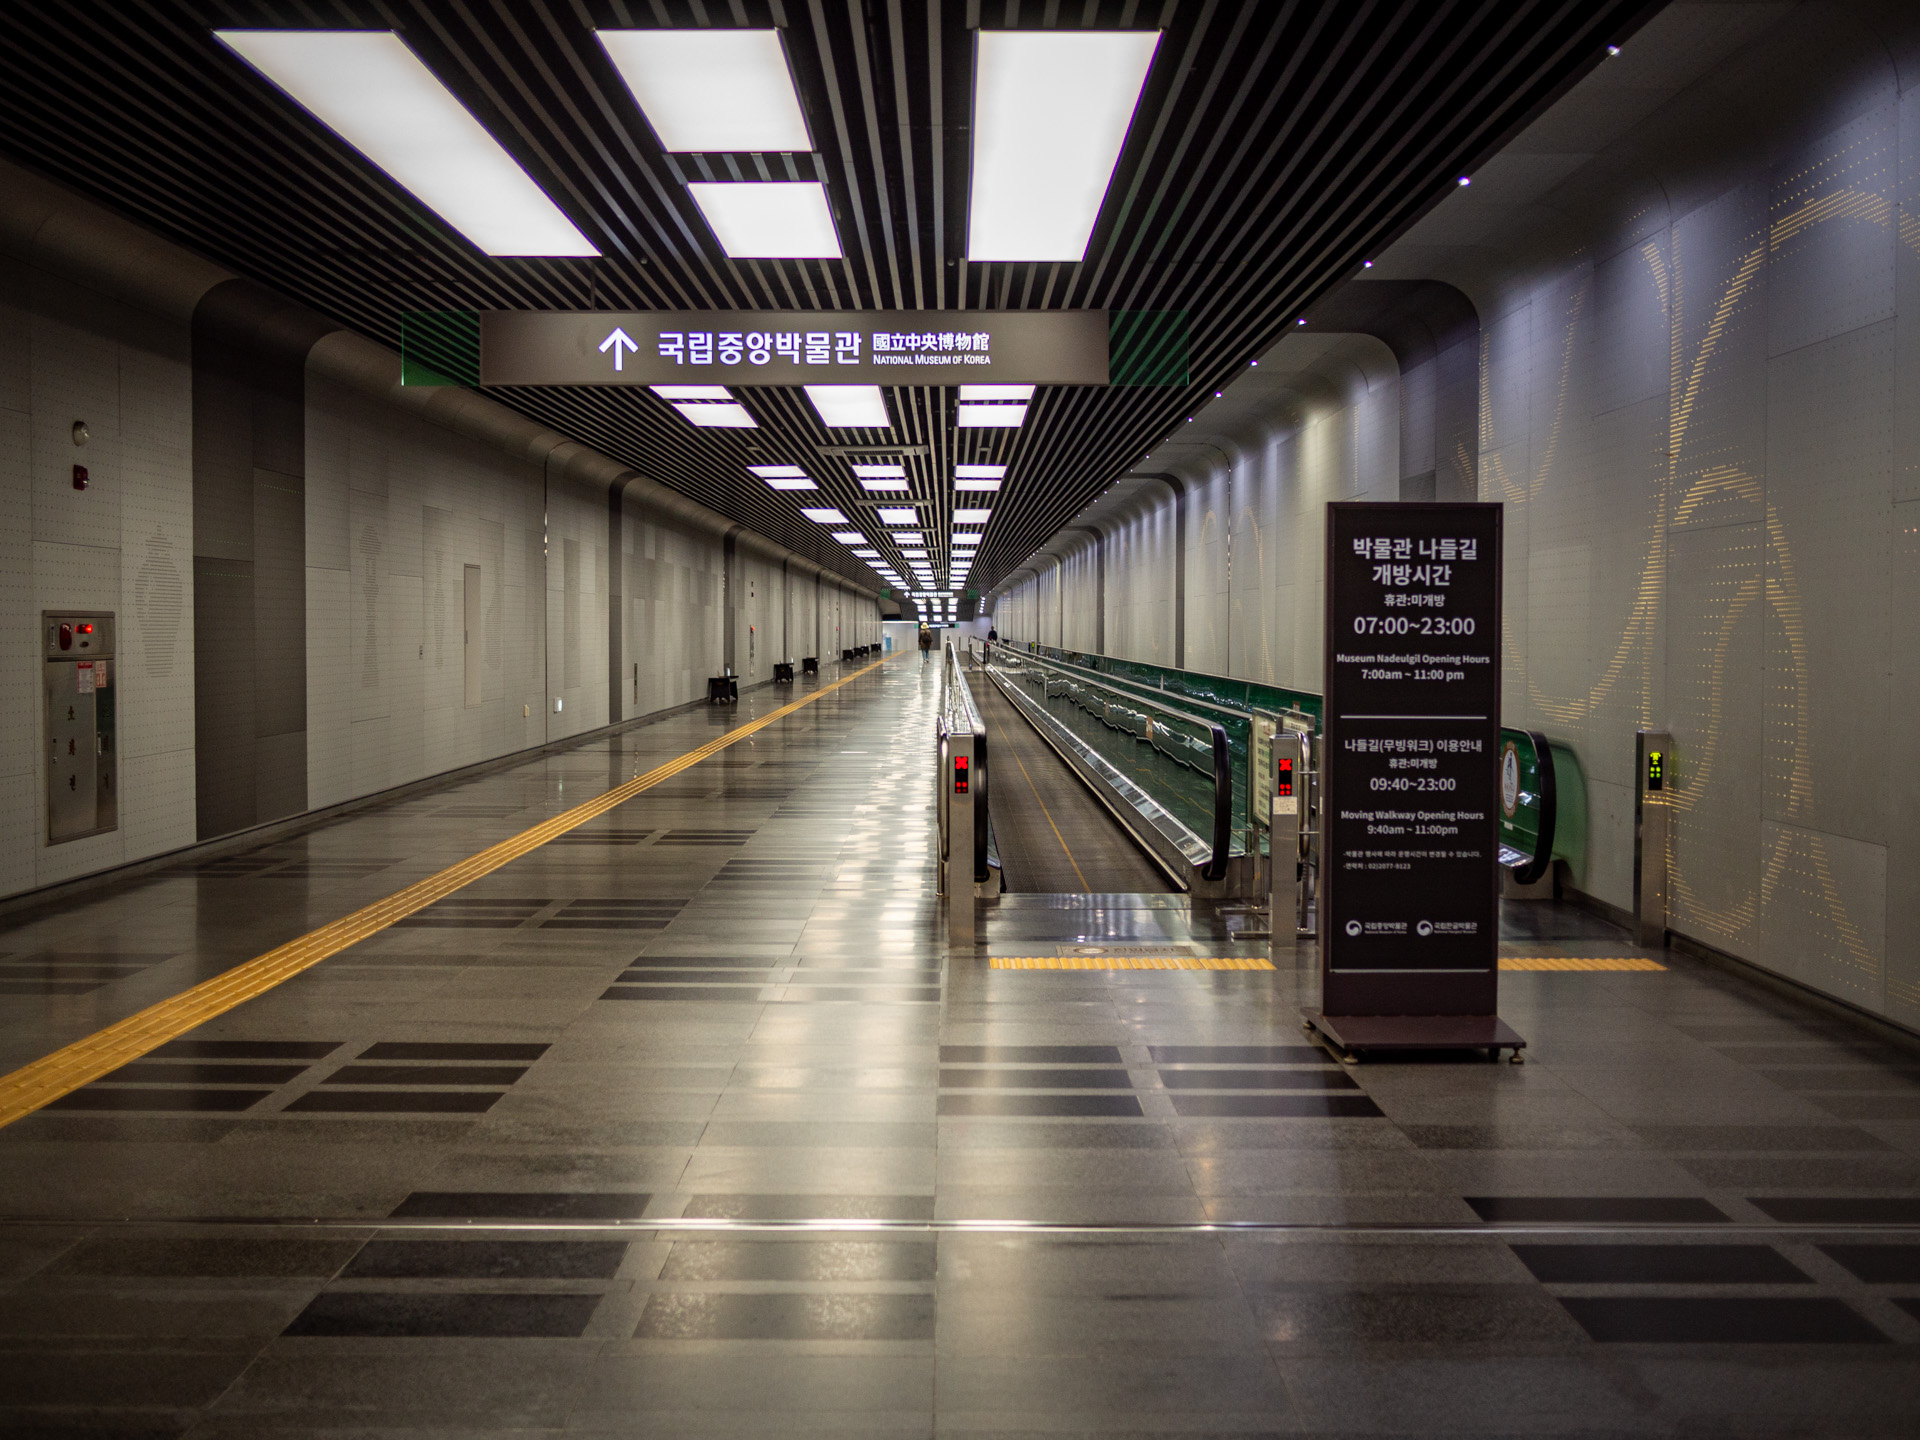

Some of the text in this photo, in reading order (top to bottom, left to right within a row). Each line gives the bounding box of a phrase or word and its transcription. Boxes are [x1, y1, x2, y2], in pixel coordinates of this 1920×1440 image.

[658, 331, 863, 366] 국립중앙박물관
[871, 331, 991, 352] 國立中央博物館
[872, 354, 991, 365] NATIONAL MUSEUM OF KOREA
[1352, 537, 1477, 561] 박물관 나들길
[1372, 563, 1453, 587] 개방시간
[1383, 593, 1446, 608] 휴관:미개방
[1353, 616, 1476, 636] 07:00~23:00
[1336, 654, 1490, 666] Museum Nadeulgil Opening Hours
[1361, 669, 1403, 680] 7:00am
[1414, 670, 1444, 681] 11:00
[1446, 673, 1465, 682] pm
[1344, 739, 1482, 754] 나들길(무빙워크) 이용안내
[1388, 758, 1438, 769] 휴관:미개방
[1369, 777, 1457, 791] 09:40~23:00
[1341, 810, 1485, 822] Moving Walkway Opening Hours
[1367, 825, 1405, 835] 9:40am
[1415, 825, 1459, 836] 11:00pm
